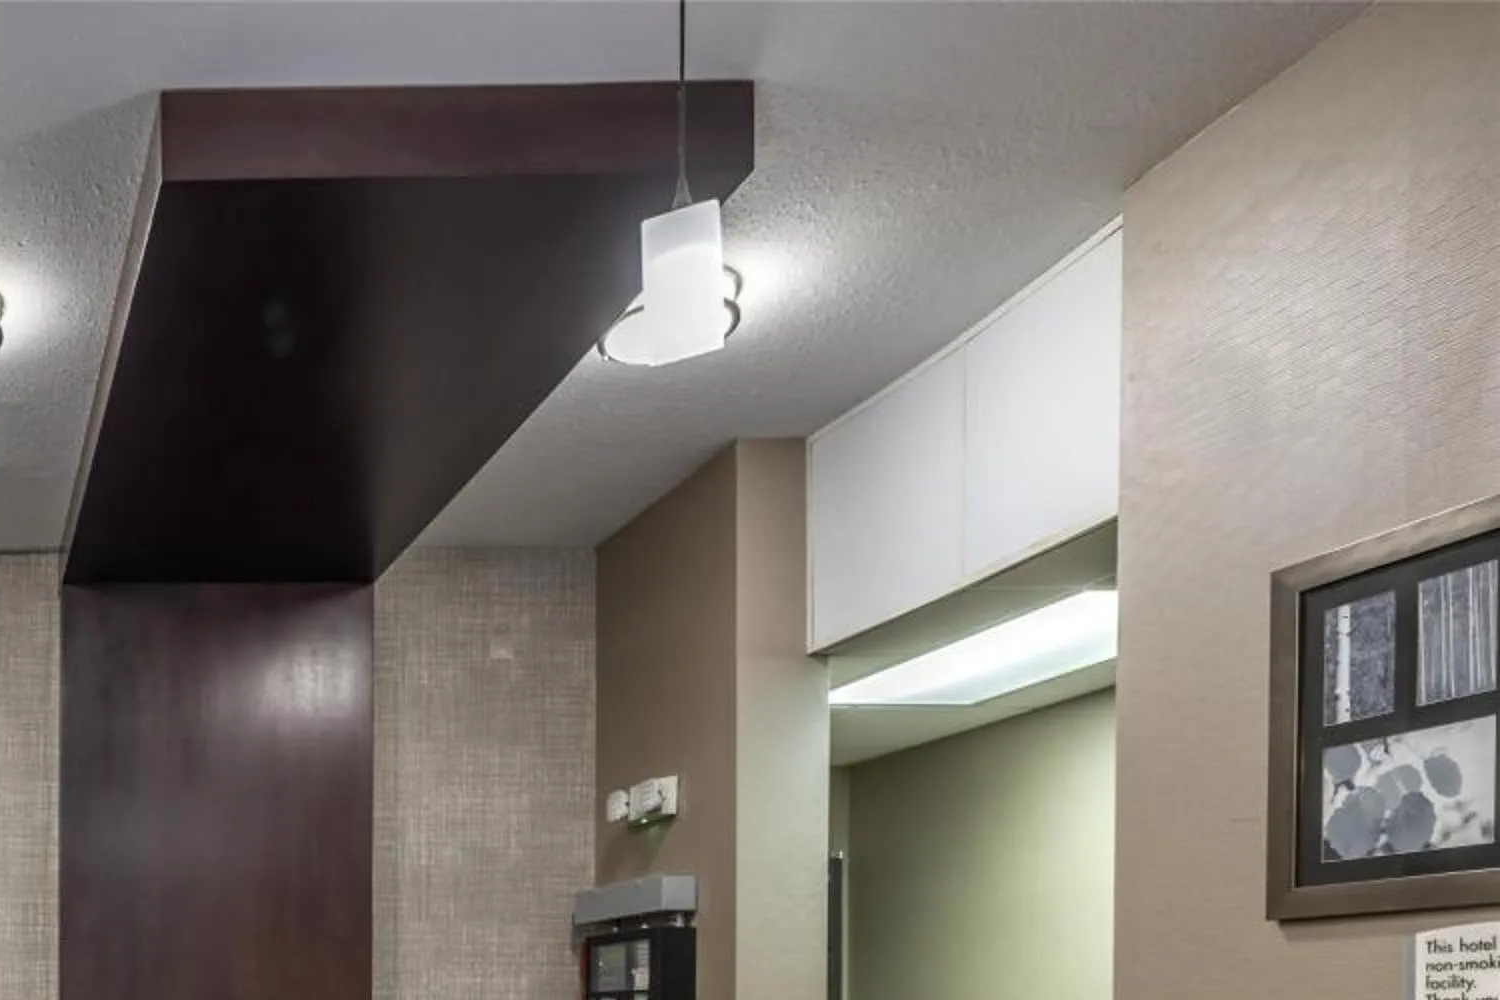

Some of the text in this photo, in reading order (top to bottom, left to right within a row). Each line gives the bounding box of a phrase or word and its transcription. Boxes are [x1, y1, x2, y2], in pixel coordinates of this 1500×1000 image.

[1425, 936, 1497, 954] This hotel
[1425, 974, 1477, 992] facility.
